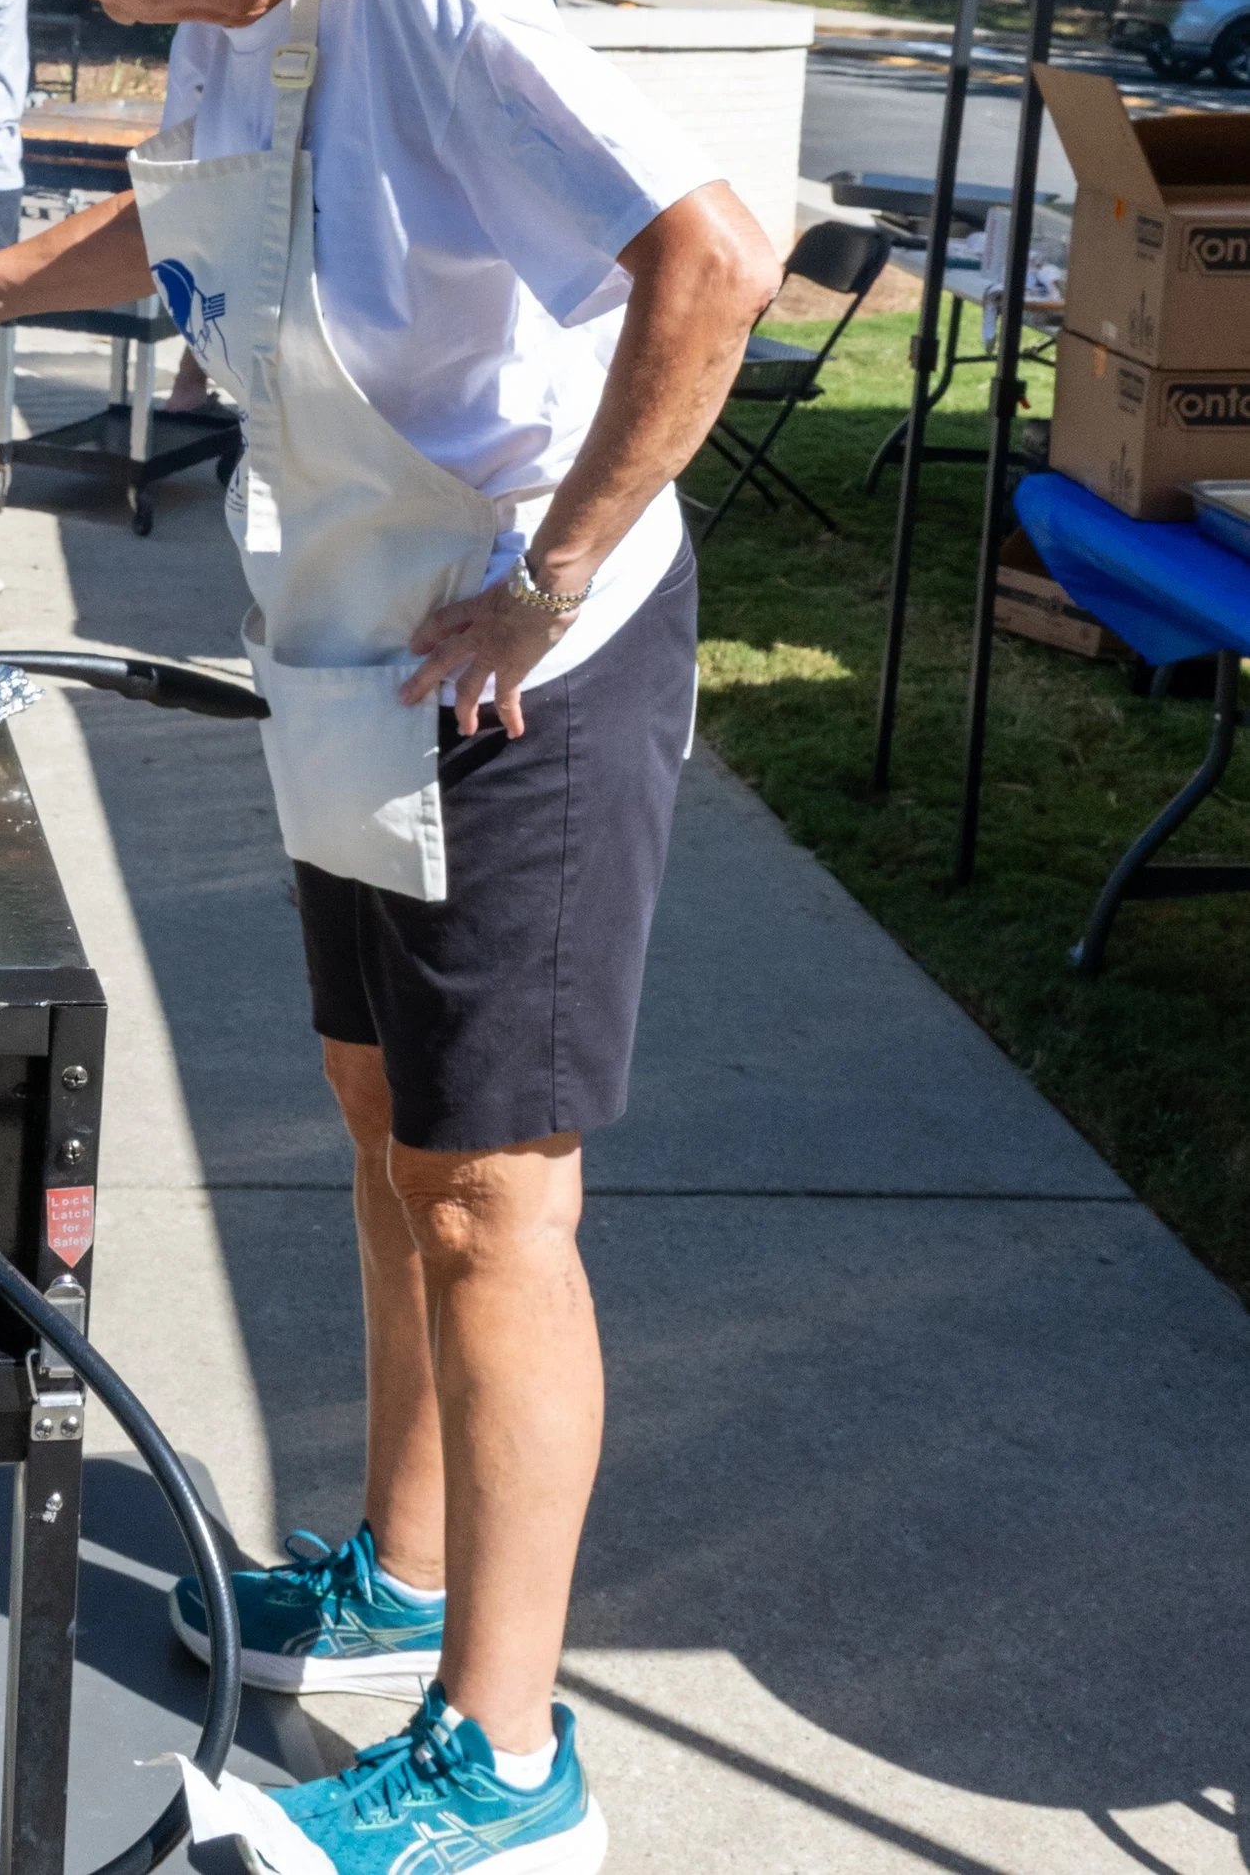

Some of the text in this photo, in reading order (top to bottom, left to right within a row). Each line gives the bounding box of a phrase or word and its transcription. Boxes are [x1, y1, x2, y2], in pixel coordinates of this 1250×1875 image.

[1182, 229, 1250, 272] Kon
[51, 1194, 91, 1207] Lock
[52, 1208, 91, 1221] Latch
[62, 1223, 81, 1233] for
[53, 1236, 91, 1248] Safety
